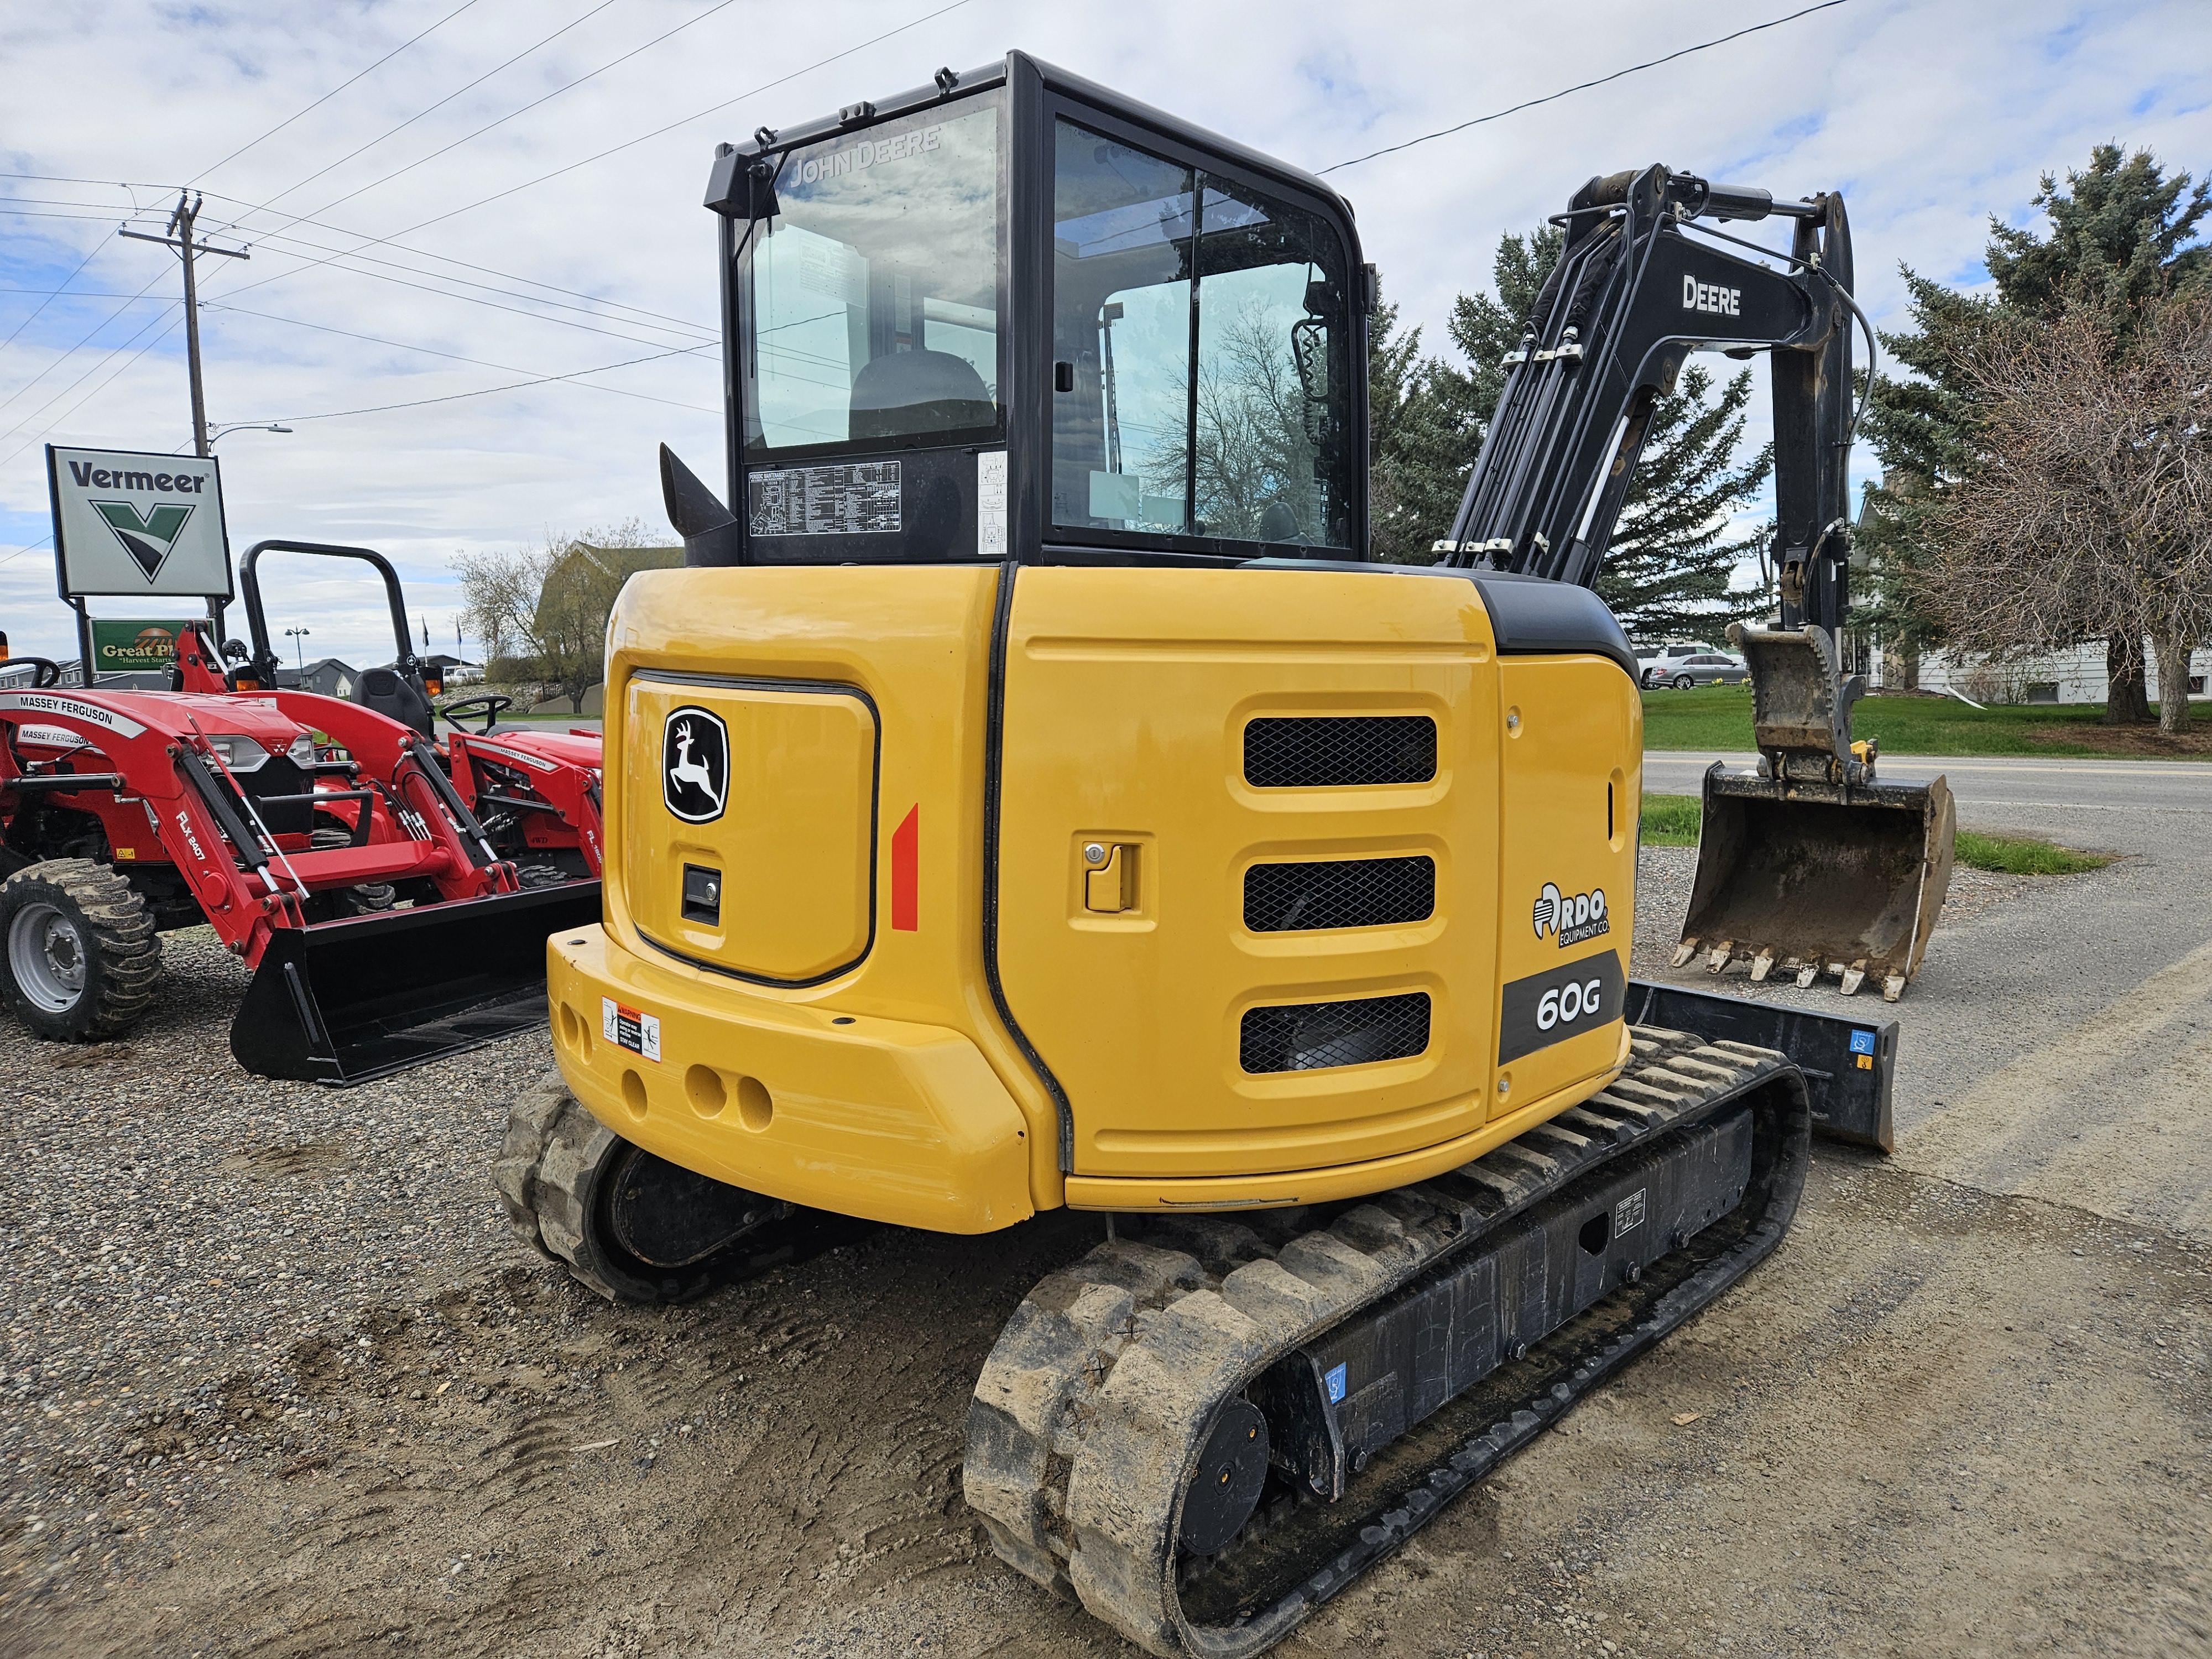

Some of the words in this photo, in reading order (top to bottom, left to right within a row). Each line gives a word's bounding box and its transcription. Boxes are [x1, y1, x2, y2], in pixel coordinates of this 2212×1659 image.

[790, 150, 852, 187] JOHN
[857, 126, 940, 170] DEERE
[1683, 274, 1740, 315] DEERE
[68, 461, 204, 493] Vermeer
[102, 645, 153, 657] Great
[156, 645, 173, 656] Pl
[20, 697, 58, 709] MASSEY
[61, 701, 112, 724] FERGUSON
[22, 730, 51, 740] MASSEY
[52, 733, 89, 745] FERGUSON
[500, 748, 520, 758] MASSEY
[521, 754, 546, 767] FERGUSON
[188, 836, 205, 860] 2407
[1559, 923, 1597, 946] EQUIPMENT
[1598, 920, 1609, 933] CO.
[622, 1006, 641, 1021] WARNING
[1537, 979, 1600, 1030] 60G
[620, 1036, 628, 1045] STAY
[628, 1040, 640, 1050] CLEAR
